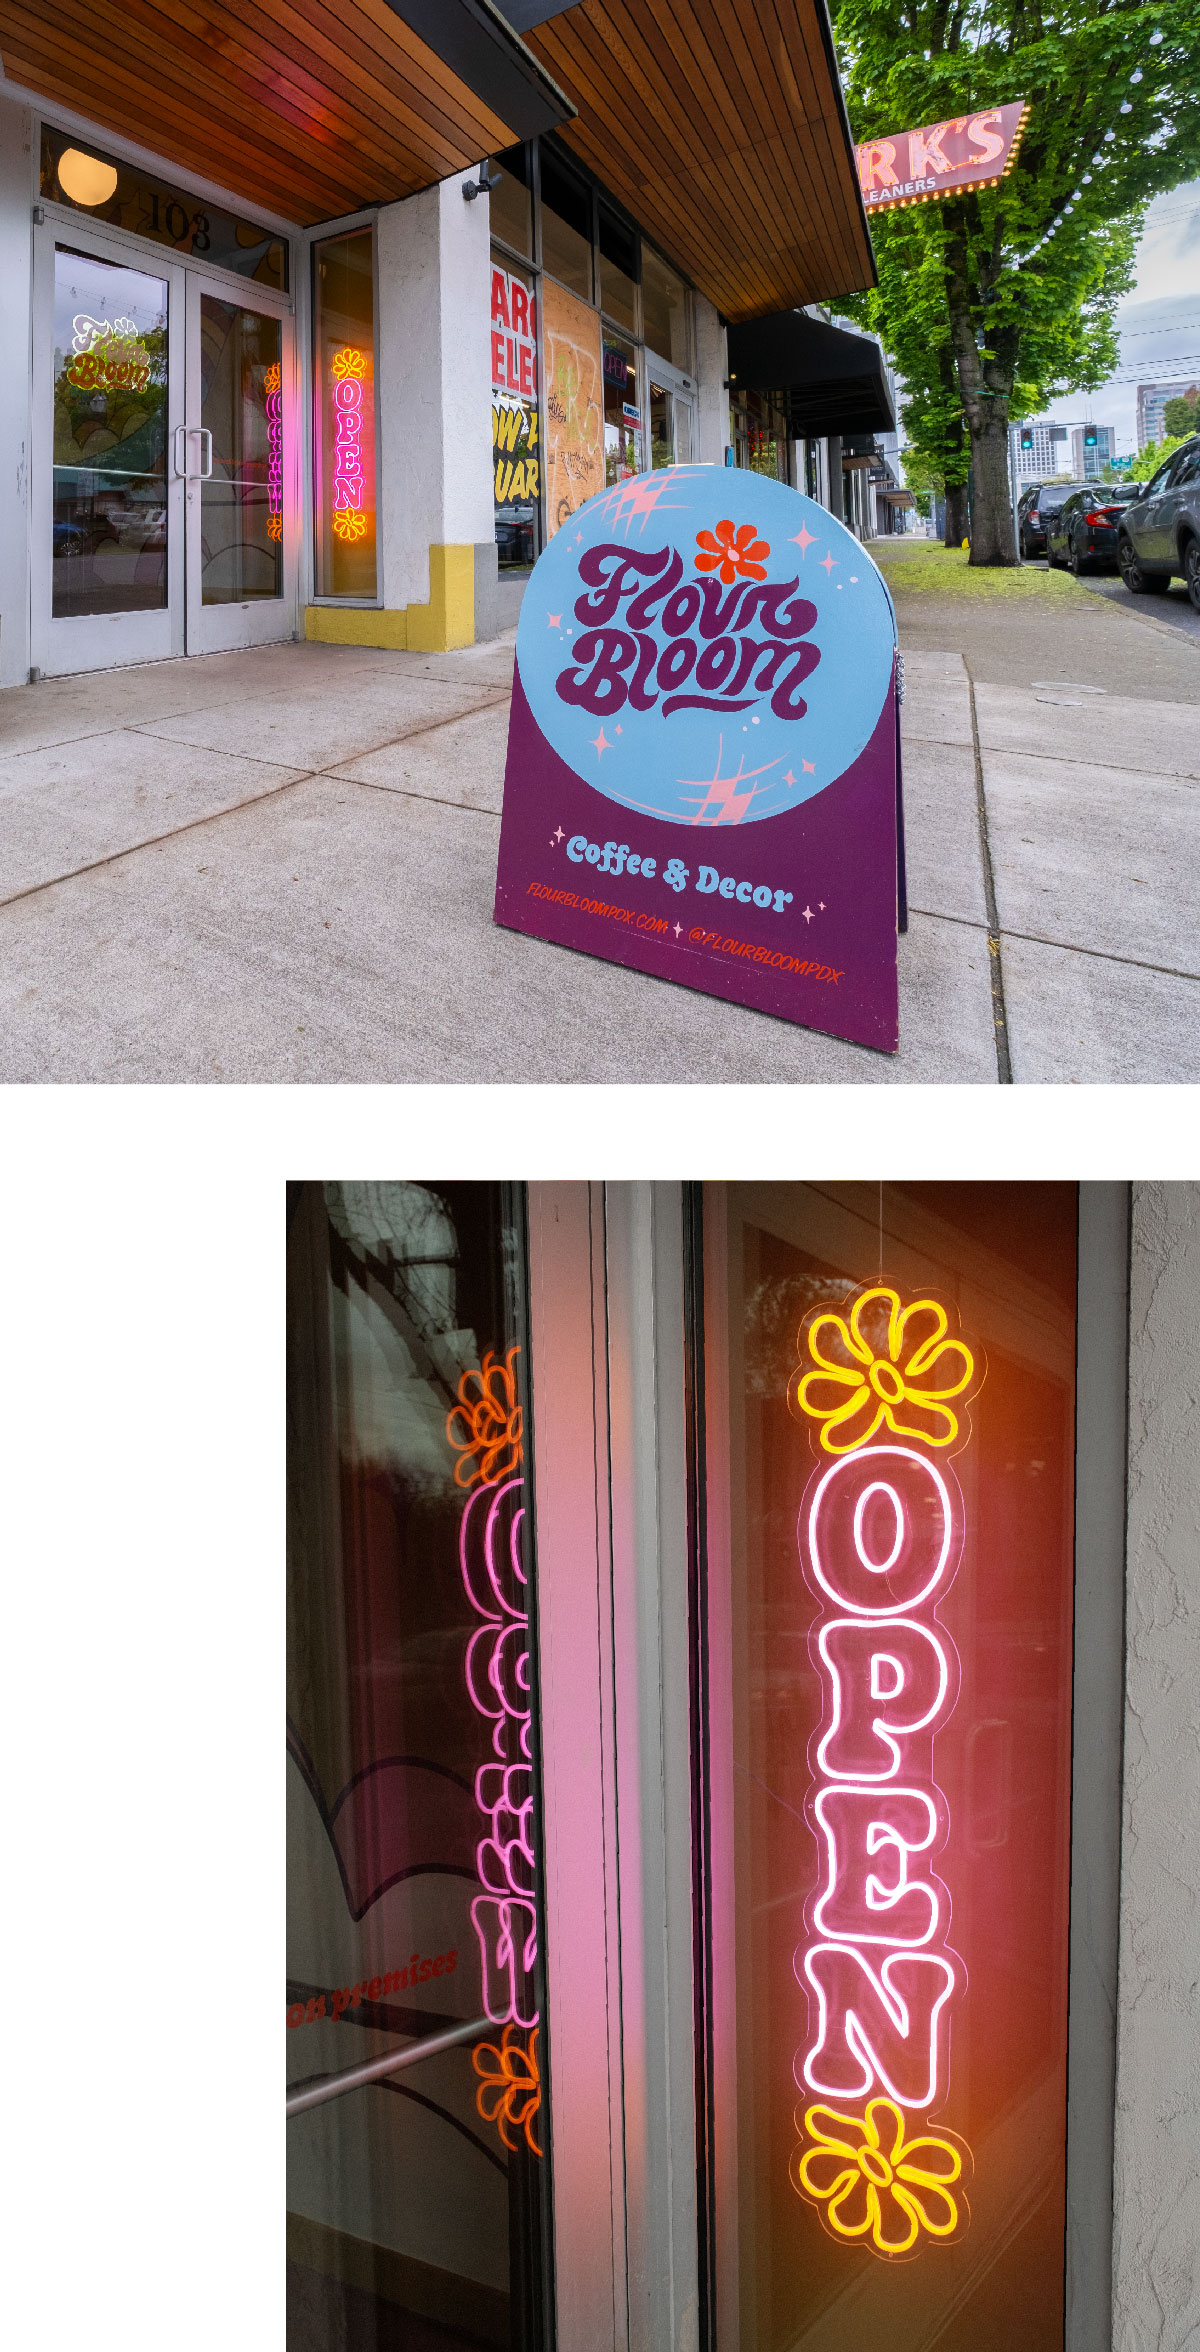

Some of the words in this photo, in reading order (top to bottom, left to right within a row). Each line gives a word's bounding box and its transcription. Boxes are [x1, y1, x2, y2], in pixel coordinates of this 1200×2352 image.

[859, 111, 1004, 190] RK'S
[145, 192, 211, 251] 103
[66, 353, 151, 393] Bloom
[604, 352, 627, 381] OPEN
[334, 378, 364, 509] OPEN
[574, 543, 818, 640] Flour
[555, 628, 821, 720] Bloom
[566, 836, 656, 878] Coffee
[663, 858, 689, 892] &
[695, 865, 793, 912] Decor
[527, 882, 669, 934] FLOURBLOOMPDX.COM
[688, 927, 845, 985] @FLOURBLOOMPDX
[803, 1446, 955, 2108] OPEN
[331, 1950, 458, 2022] premises
